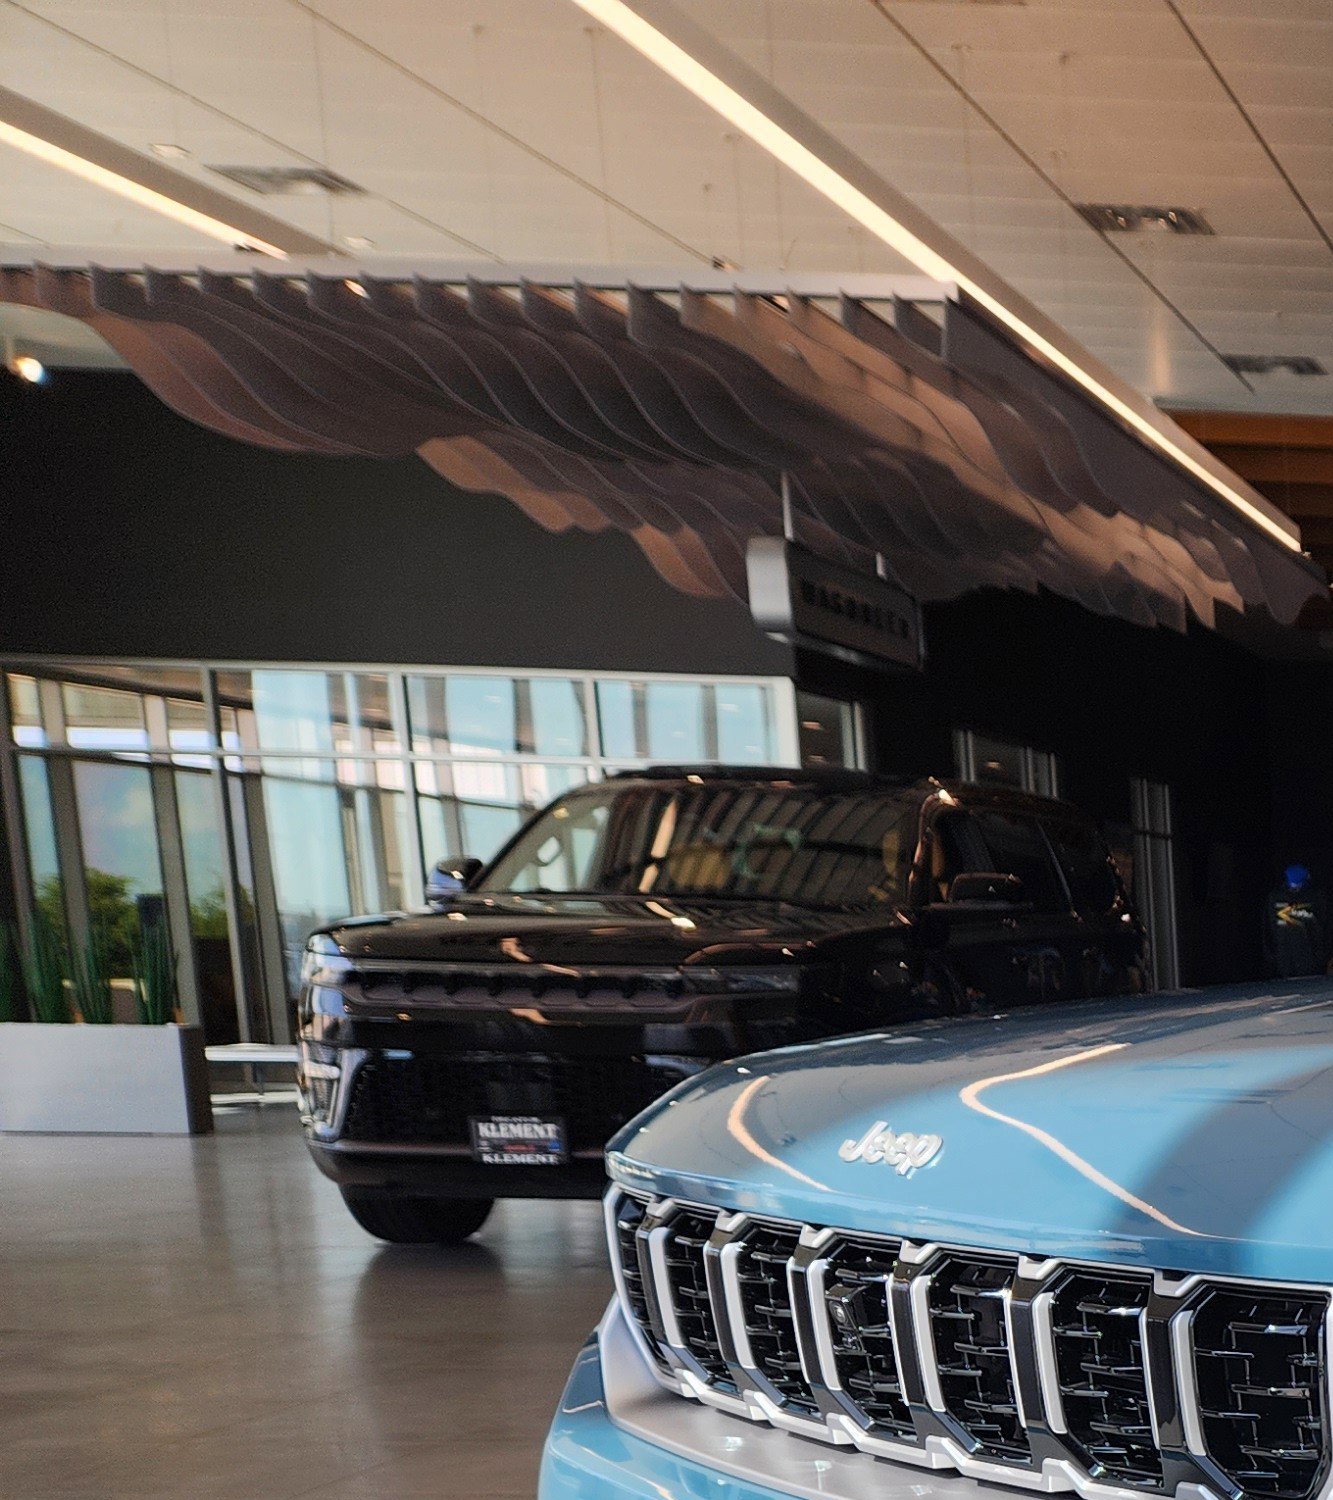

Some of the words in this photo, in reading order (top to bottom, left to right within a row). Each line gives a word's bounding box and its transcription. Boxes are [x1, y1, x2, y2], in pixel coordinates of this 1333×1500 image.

[478, 1122, 560, 1139] KLEMENT
[838, 1120, 943, 1176] Jeep
[482, 1153, 560, 1165] KLEMENT
